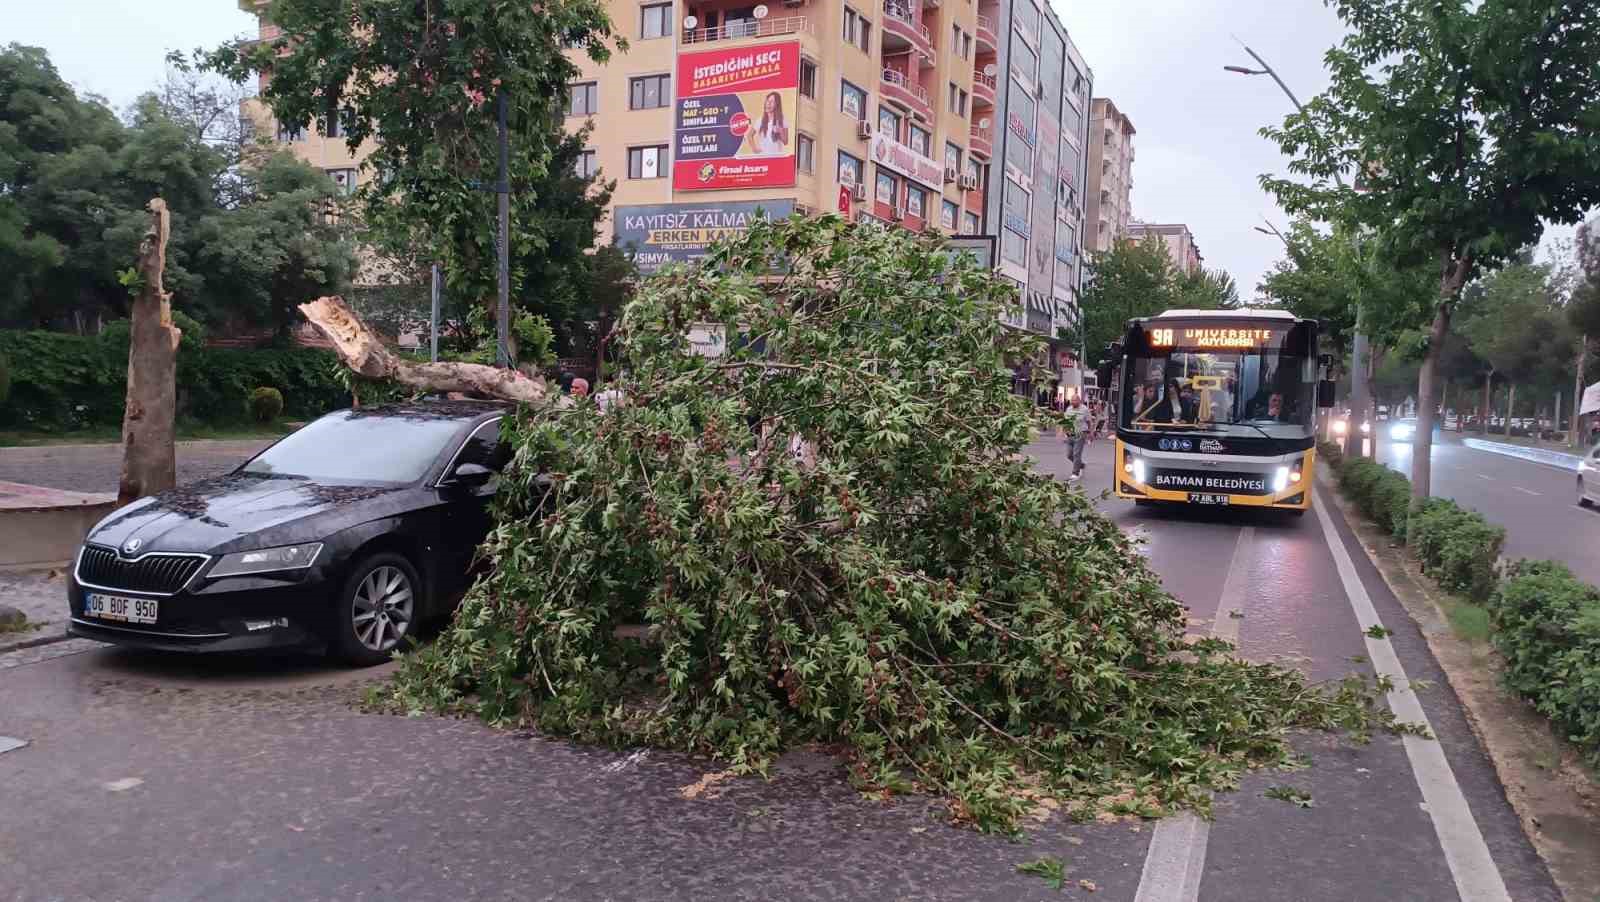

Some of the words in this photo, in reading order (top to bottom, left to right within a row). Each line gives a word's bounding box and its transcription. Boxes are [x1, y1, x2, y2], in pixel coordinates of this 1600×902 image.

[741, 64, 780, 78] YAKALA
[683, 100, 701, 108] ÖZEL
[682, 134, 700, 144] ÖZEL
[625, 214, 688, 230] KAYITSIZ
[654, 231, 700, 242] ERKEN
[1156, 475, 1203, 486] BATMAN
[1206, 478, 1264, 490] BELEDİYESİ
[92, 595, 104, 611] 06
[135, 600, 156, 618] 950
